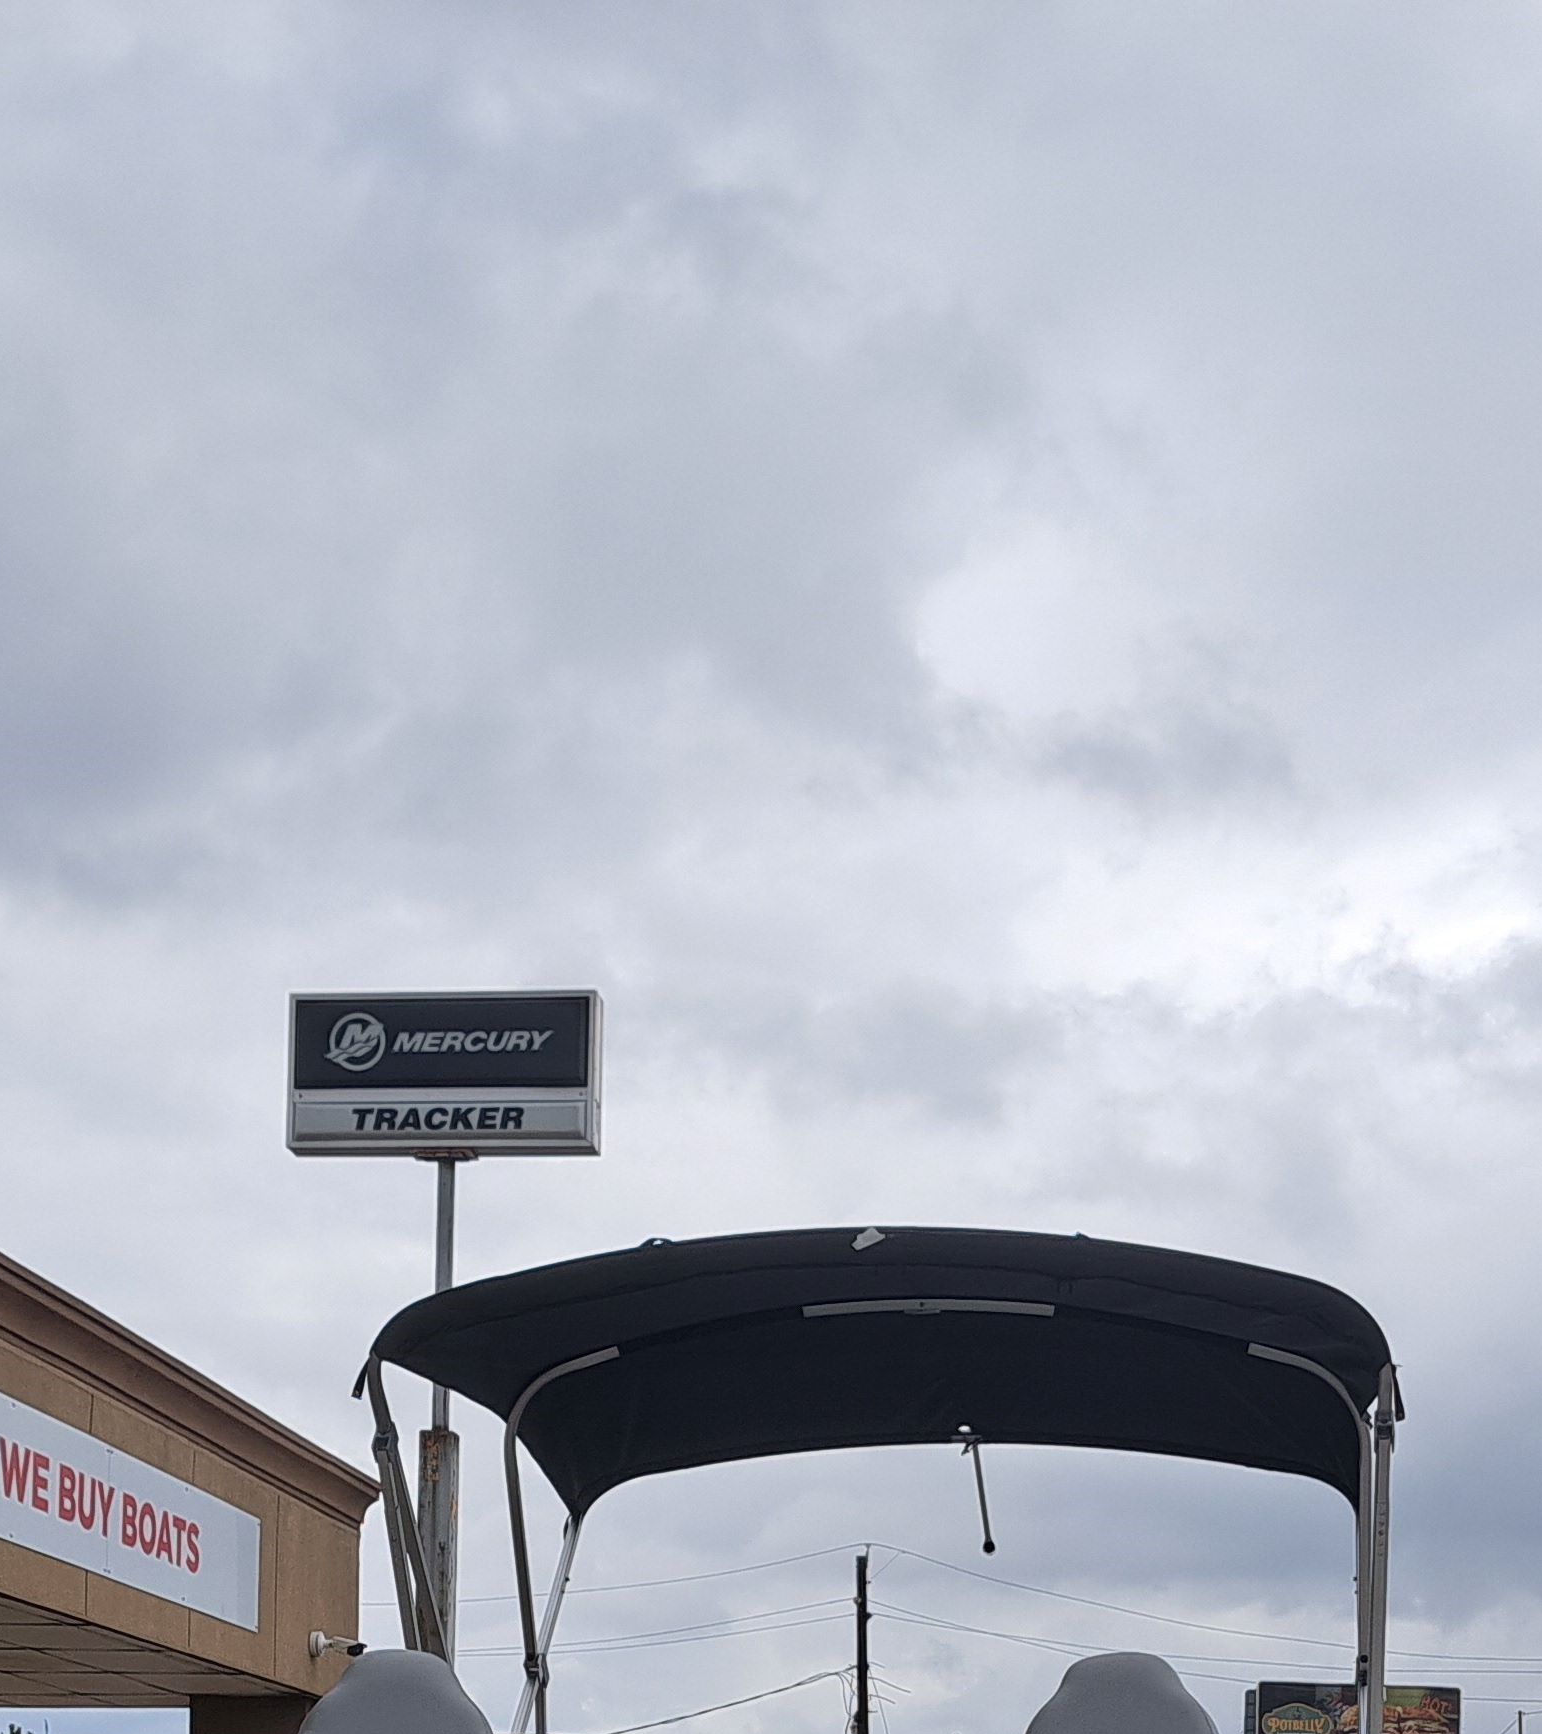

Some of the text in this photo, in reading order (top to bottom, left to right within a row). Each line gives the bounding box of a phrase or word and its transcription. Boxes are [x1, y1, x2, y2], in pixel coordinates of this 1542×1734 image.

[392, 1029, 555, 1053] MERCURY
[351, 1106, 525, 1131] TRACKER
[58, 1463, 115, 1538] BUY
[121, 1491, 201, 1574] BOATS
[1267, 1716, 1326, 1734] POTBELLY
